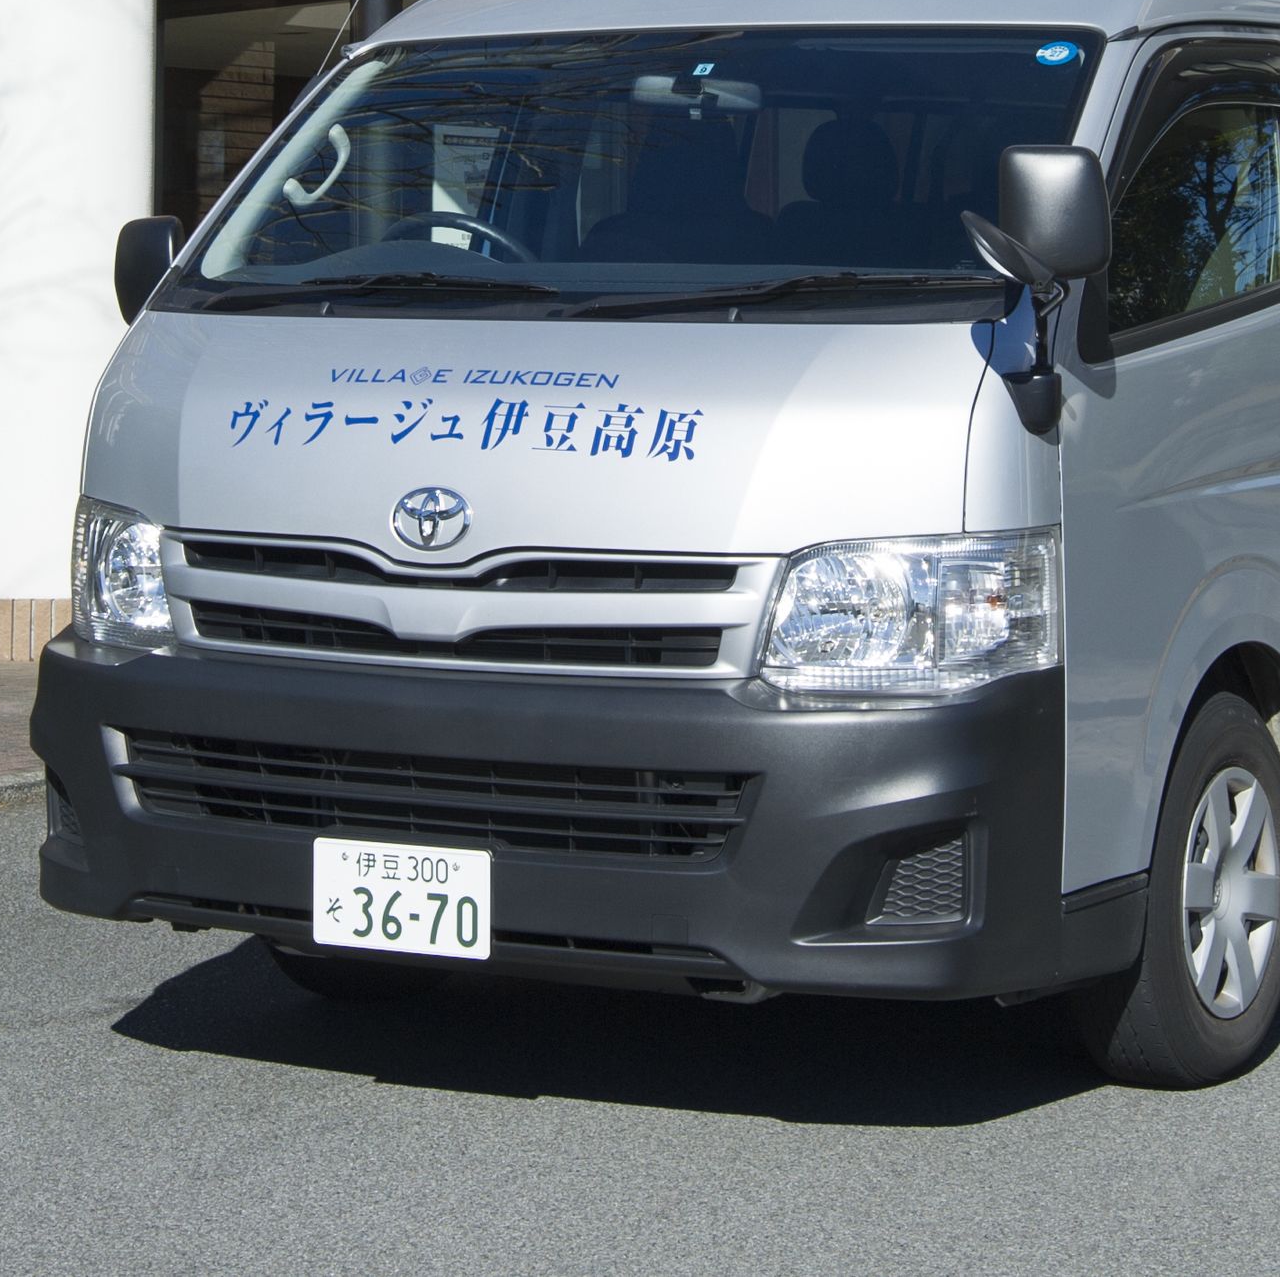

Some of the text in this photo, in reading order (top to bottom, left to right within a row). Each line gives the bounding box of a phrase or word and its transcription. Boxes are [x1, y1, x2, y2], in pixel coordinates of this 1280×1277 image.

[329, 366, 620, 390] VILLAGE IZUKOGEN
[229, 397, 705, 462] ヴィラージュ伊豆高原
[326, 886, 479, 949] そ 36-70
